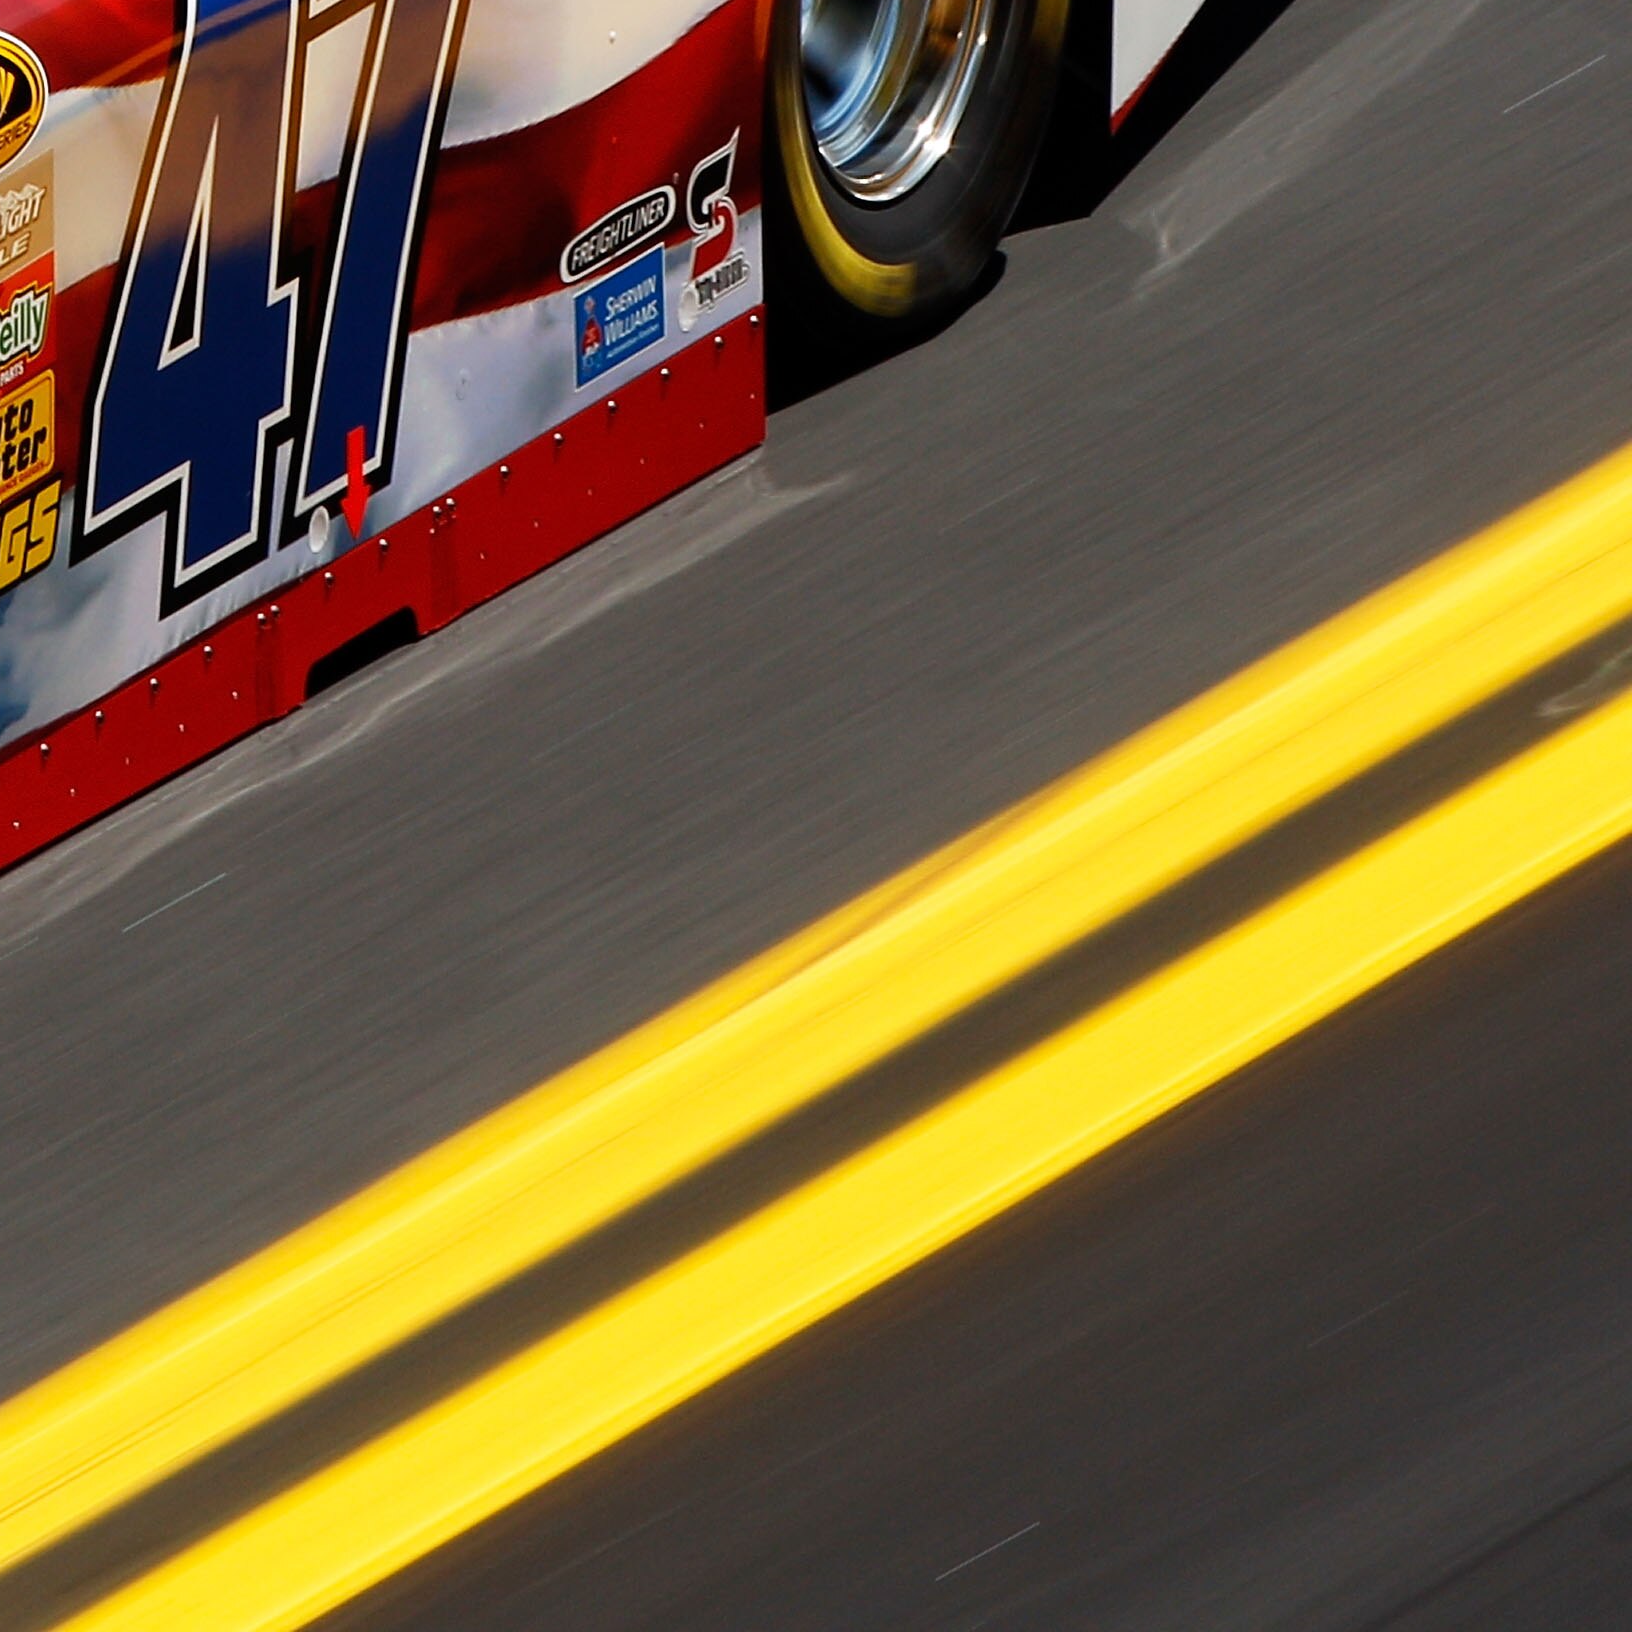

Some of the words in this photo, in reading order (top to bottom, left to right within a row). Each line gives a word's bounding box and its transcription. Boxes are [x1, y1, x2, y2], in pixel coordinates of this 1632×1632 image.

[570, 195, 666, 273] FREIGHTLINER
[604, 273, 658, 321] SHERWIN
[604, 299, 660, 347] WILLIAMS
[0, 363, 25, 390] PARTS
